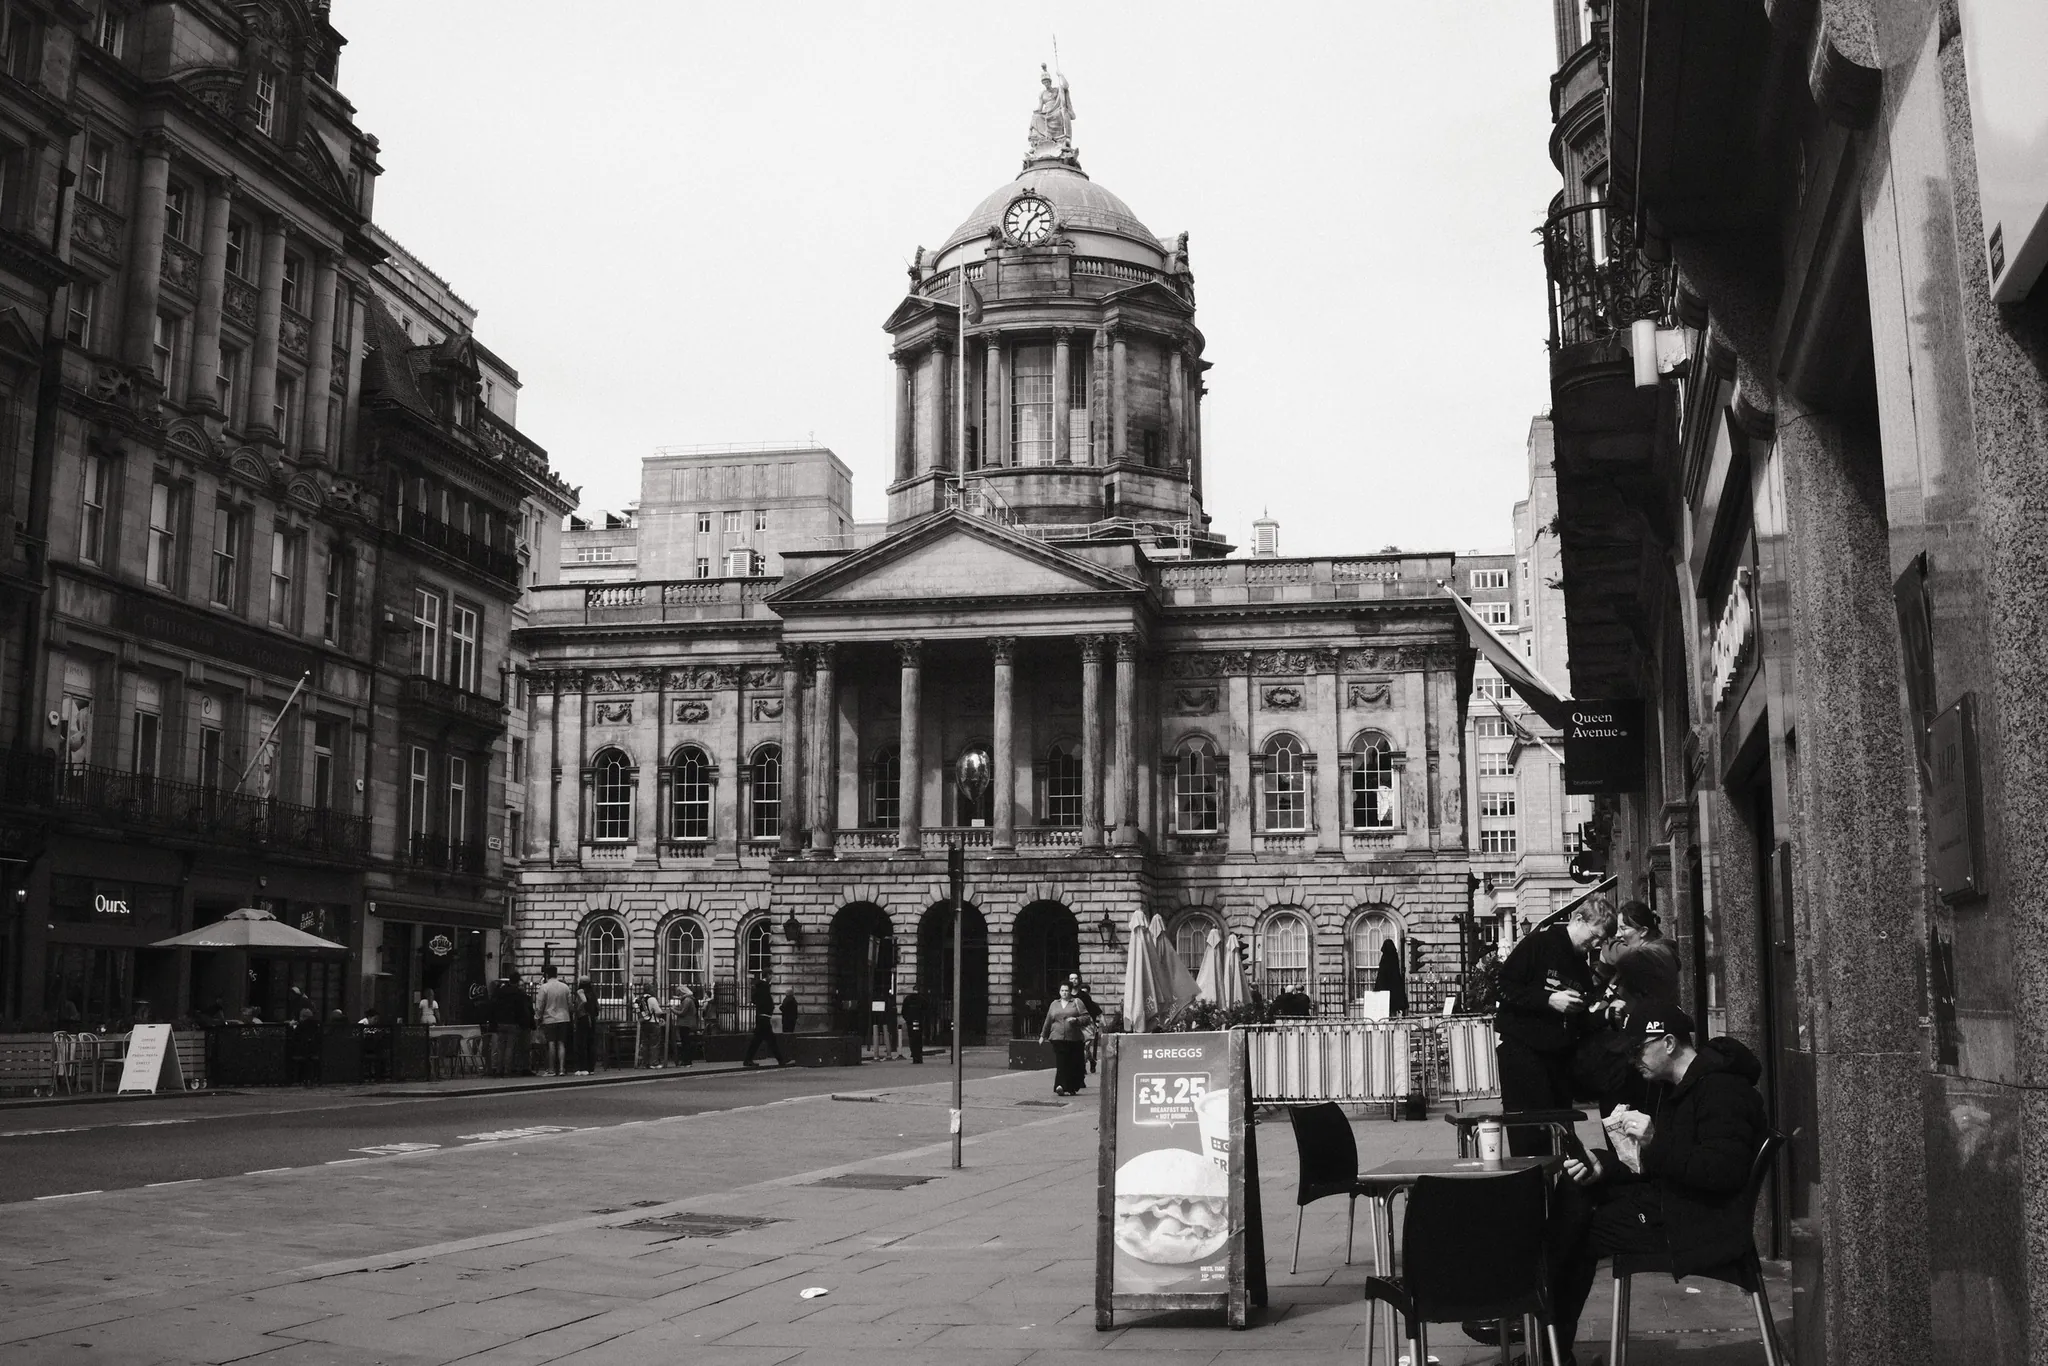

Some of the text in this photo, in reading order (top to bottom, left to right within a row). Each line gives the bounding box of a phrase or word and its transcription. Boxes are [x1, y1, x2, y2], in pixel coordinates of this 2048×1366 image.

[1571, 712, 1613, 726] Queen
[95, 894, 130, 914] Ours.
[1155, 1048, 1202, 1058] GREGGS
[1139, 1077, 1206, 1104] £3.25
